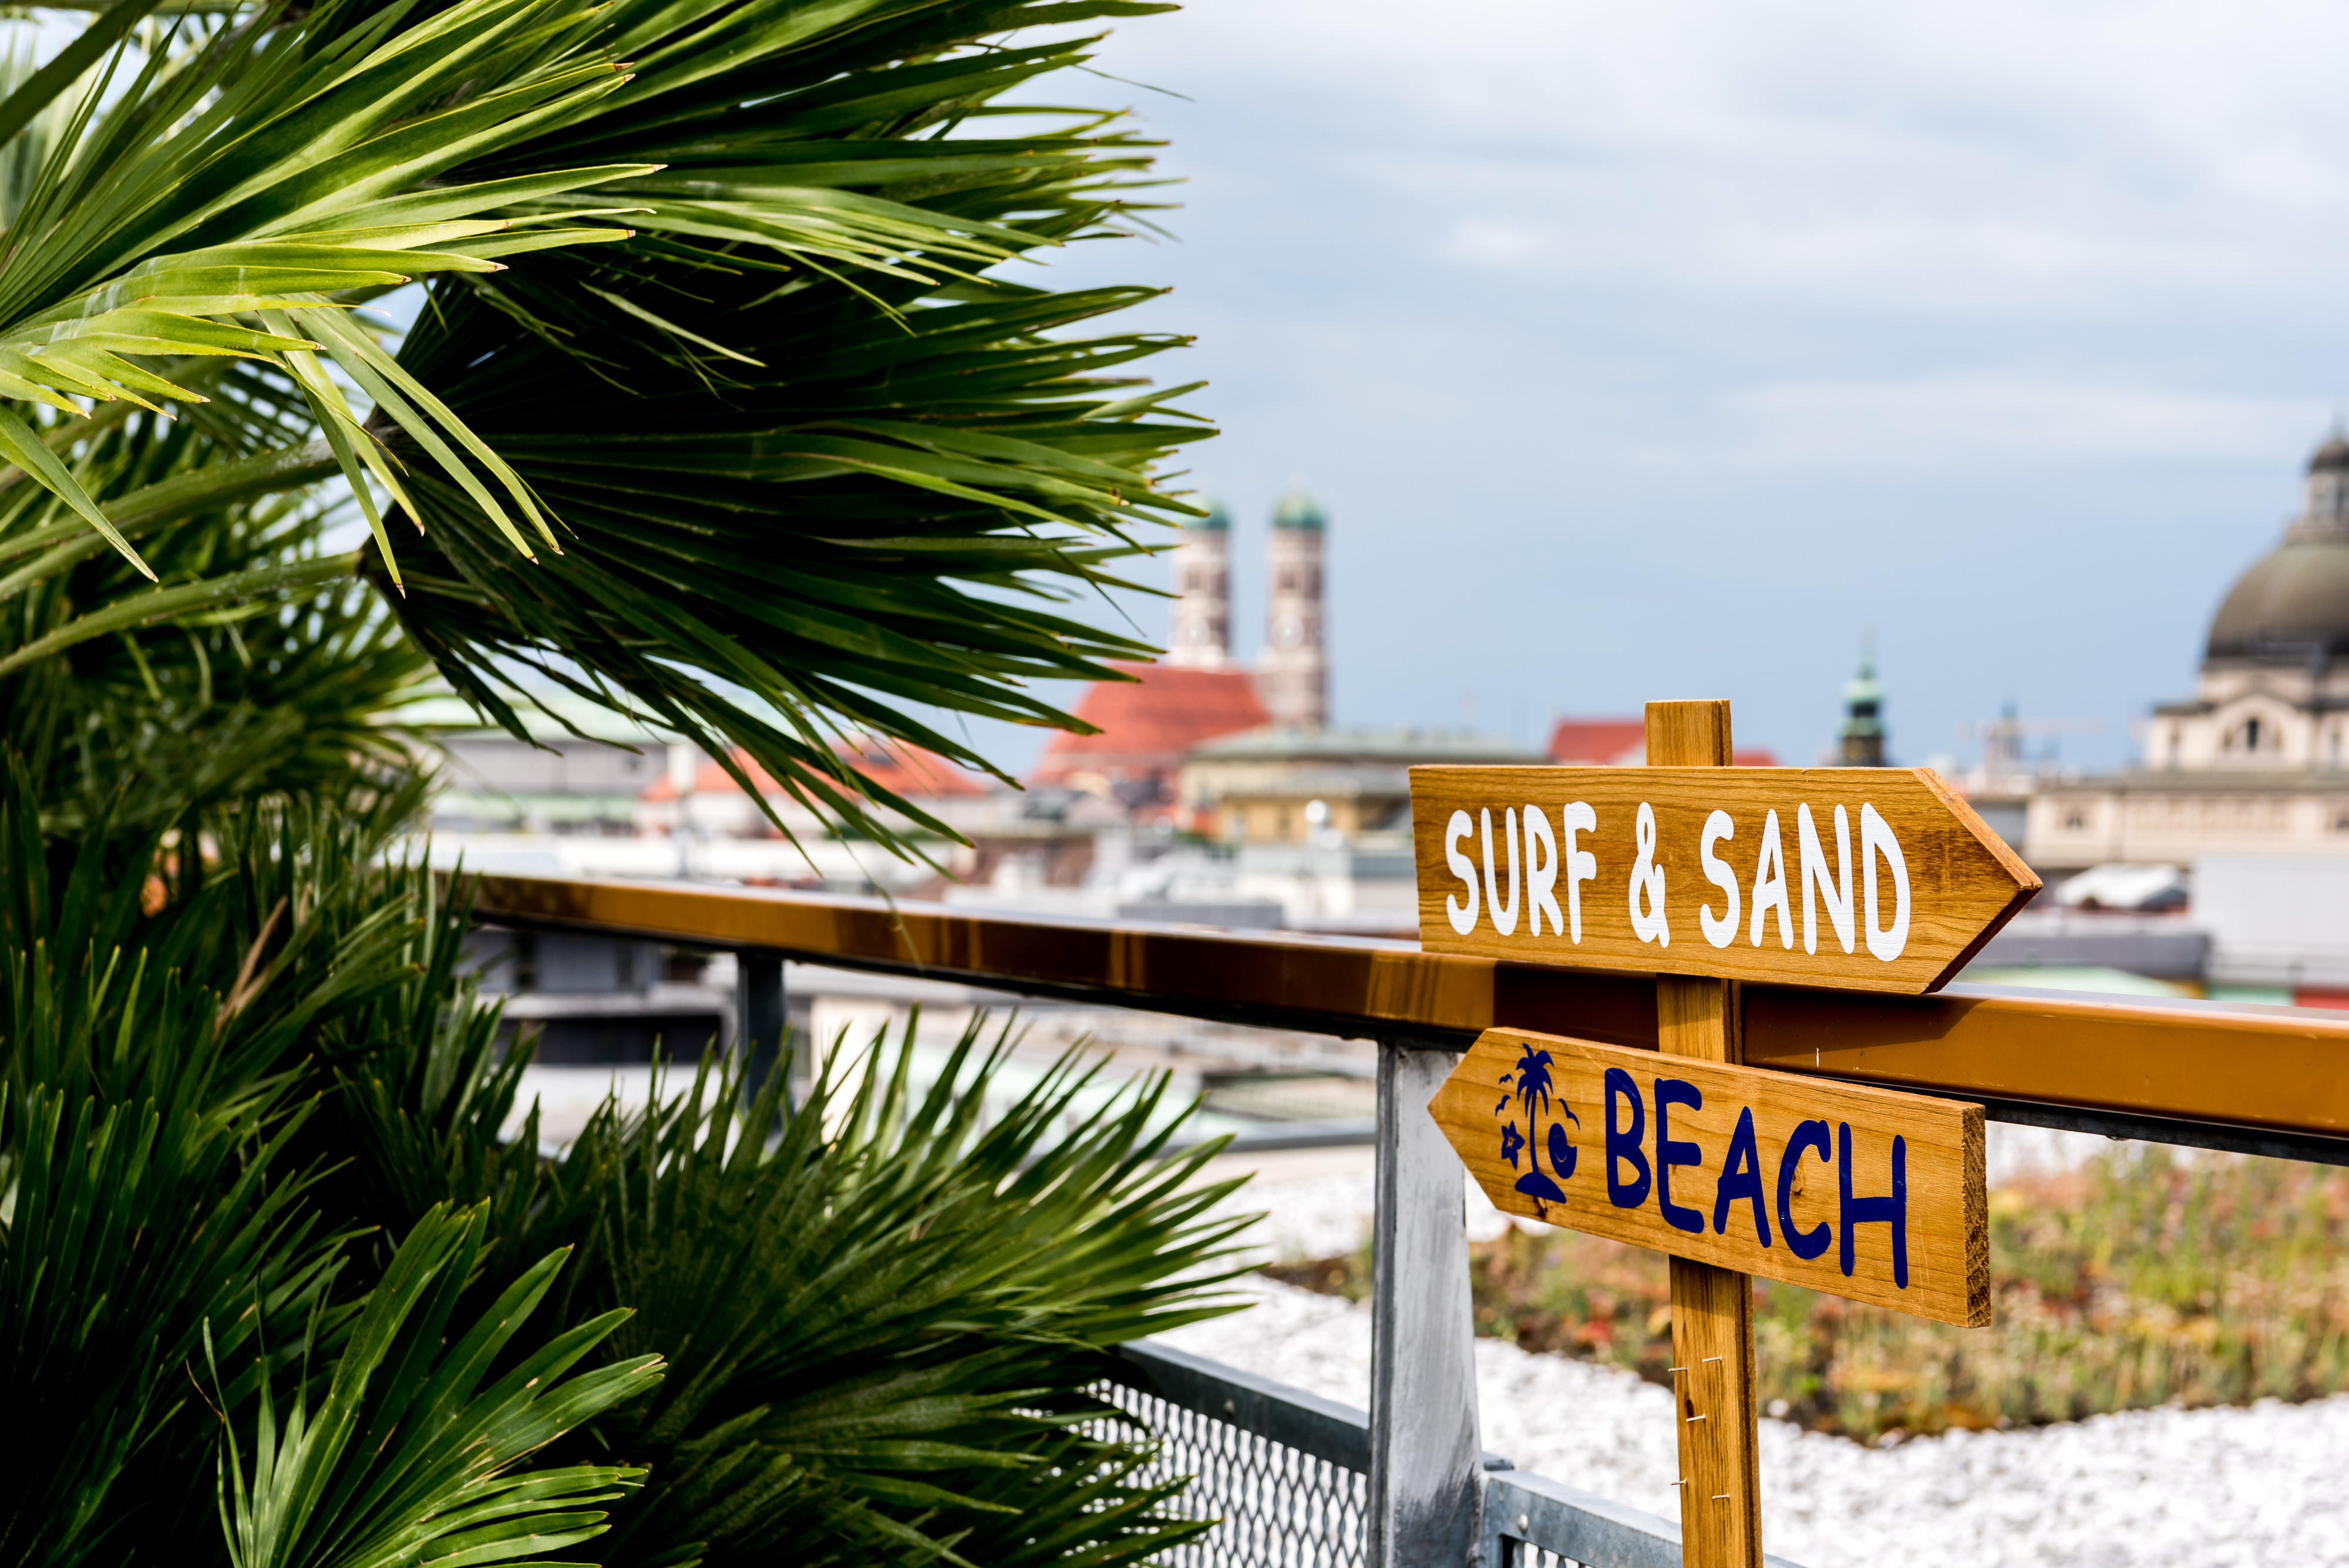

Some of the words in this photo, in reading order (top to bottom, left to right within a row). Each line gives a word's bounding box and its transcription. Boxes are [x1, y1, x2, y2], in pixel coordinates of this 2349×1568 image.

[1445, 800, 1597, 945] SURF
[1628, 801, 1670, 948] &
[1700, 801, 1911, 963] SAND
[1604, 1067, 1908, 1289] BEACH
